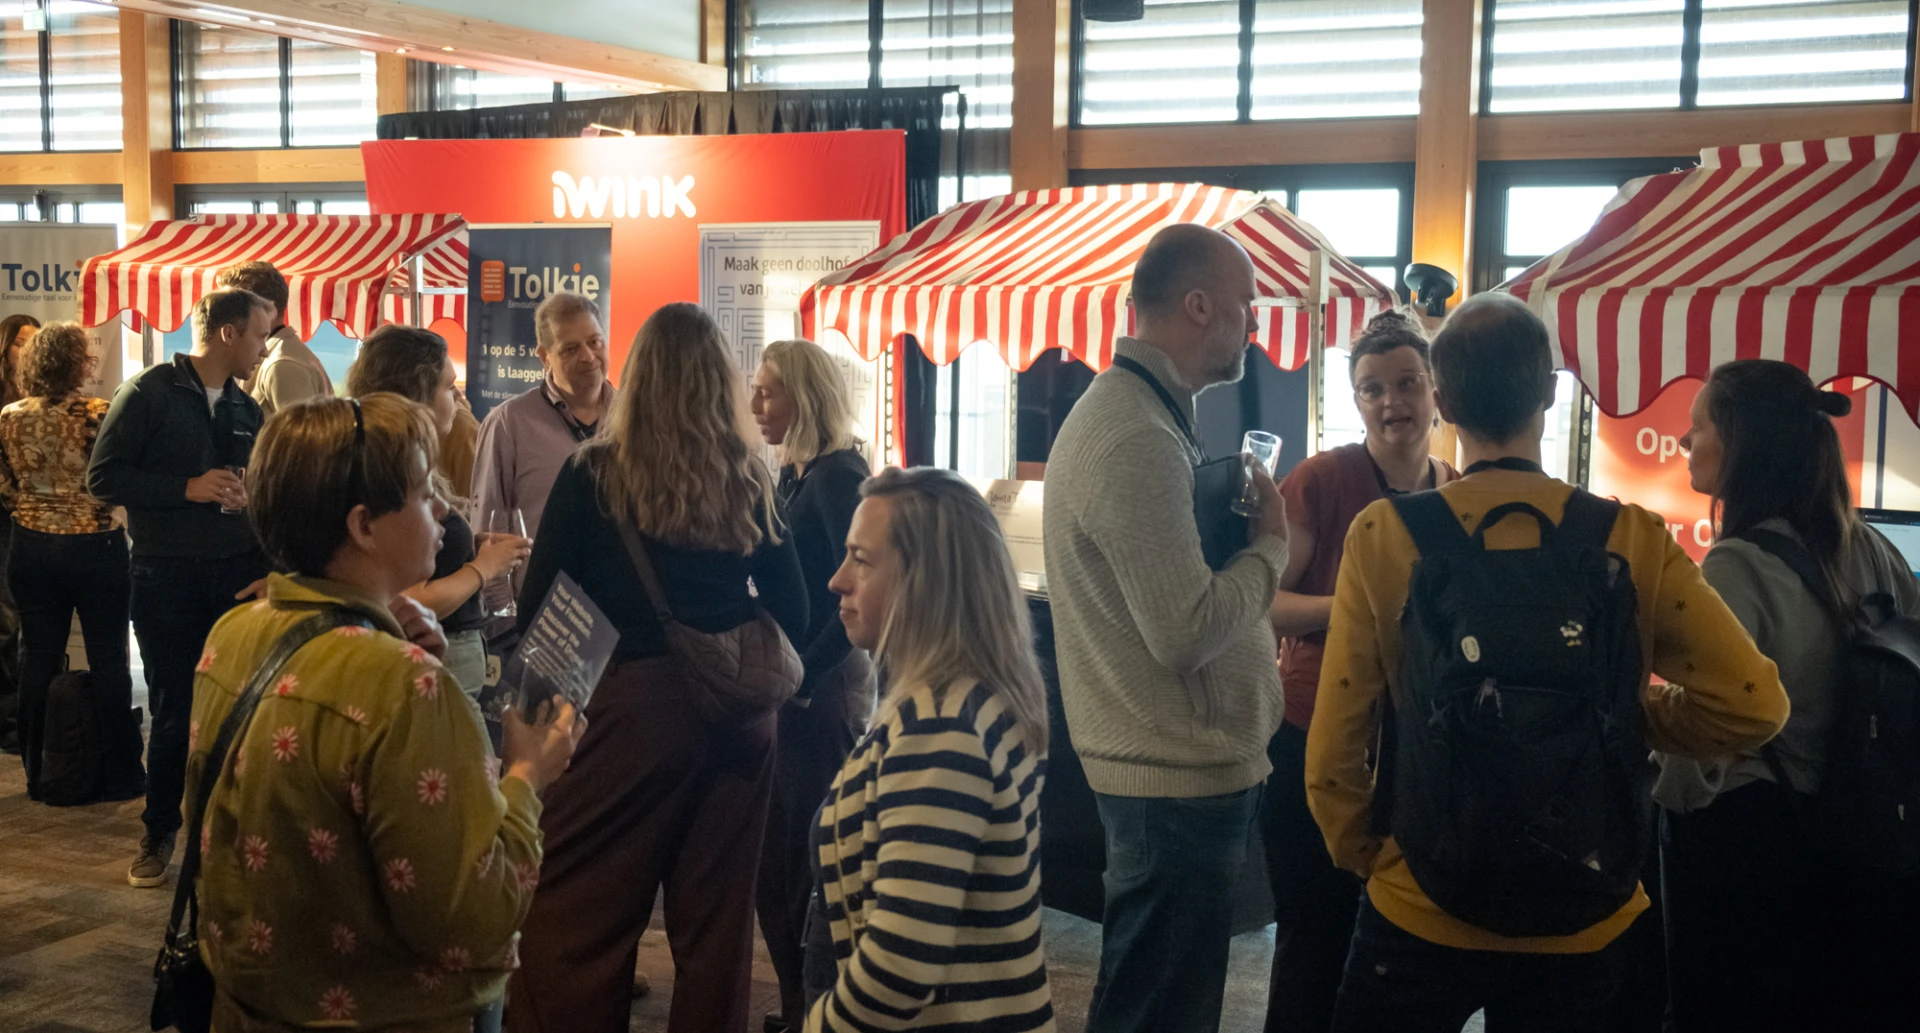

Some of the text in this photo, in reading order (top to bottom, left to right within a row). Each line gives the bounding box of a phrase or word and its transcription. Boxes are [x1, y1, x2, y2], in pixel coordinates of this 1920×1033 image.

[724, 256, 759, 271] Maak
[762, 260, 793, 275] geen
[509, 262, 600, 300] Tolkie
[740, 284, 763, 295] van
[483, 343, 488, 355] 1
[490, 345, 502, 358] op
[504, 344, 516, 356] de
[519, 345, 526, 356] 5
[497, 364, 545, 382] is laaggel
